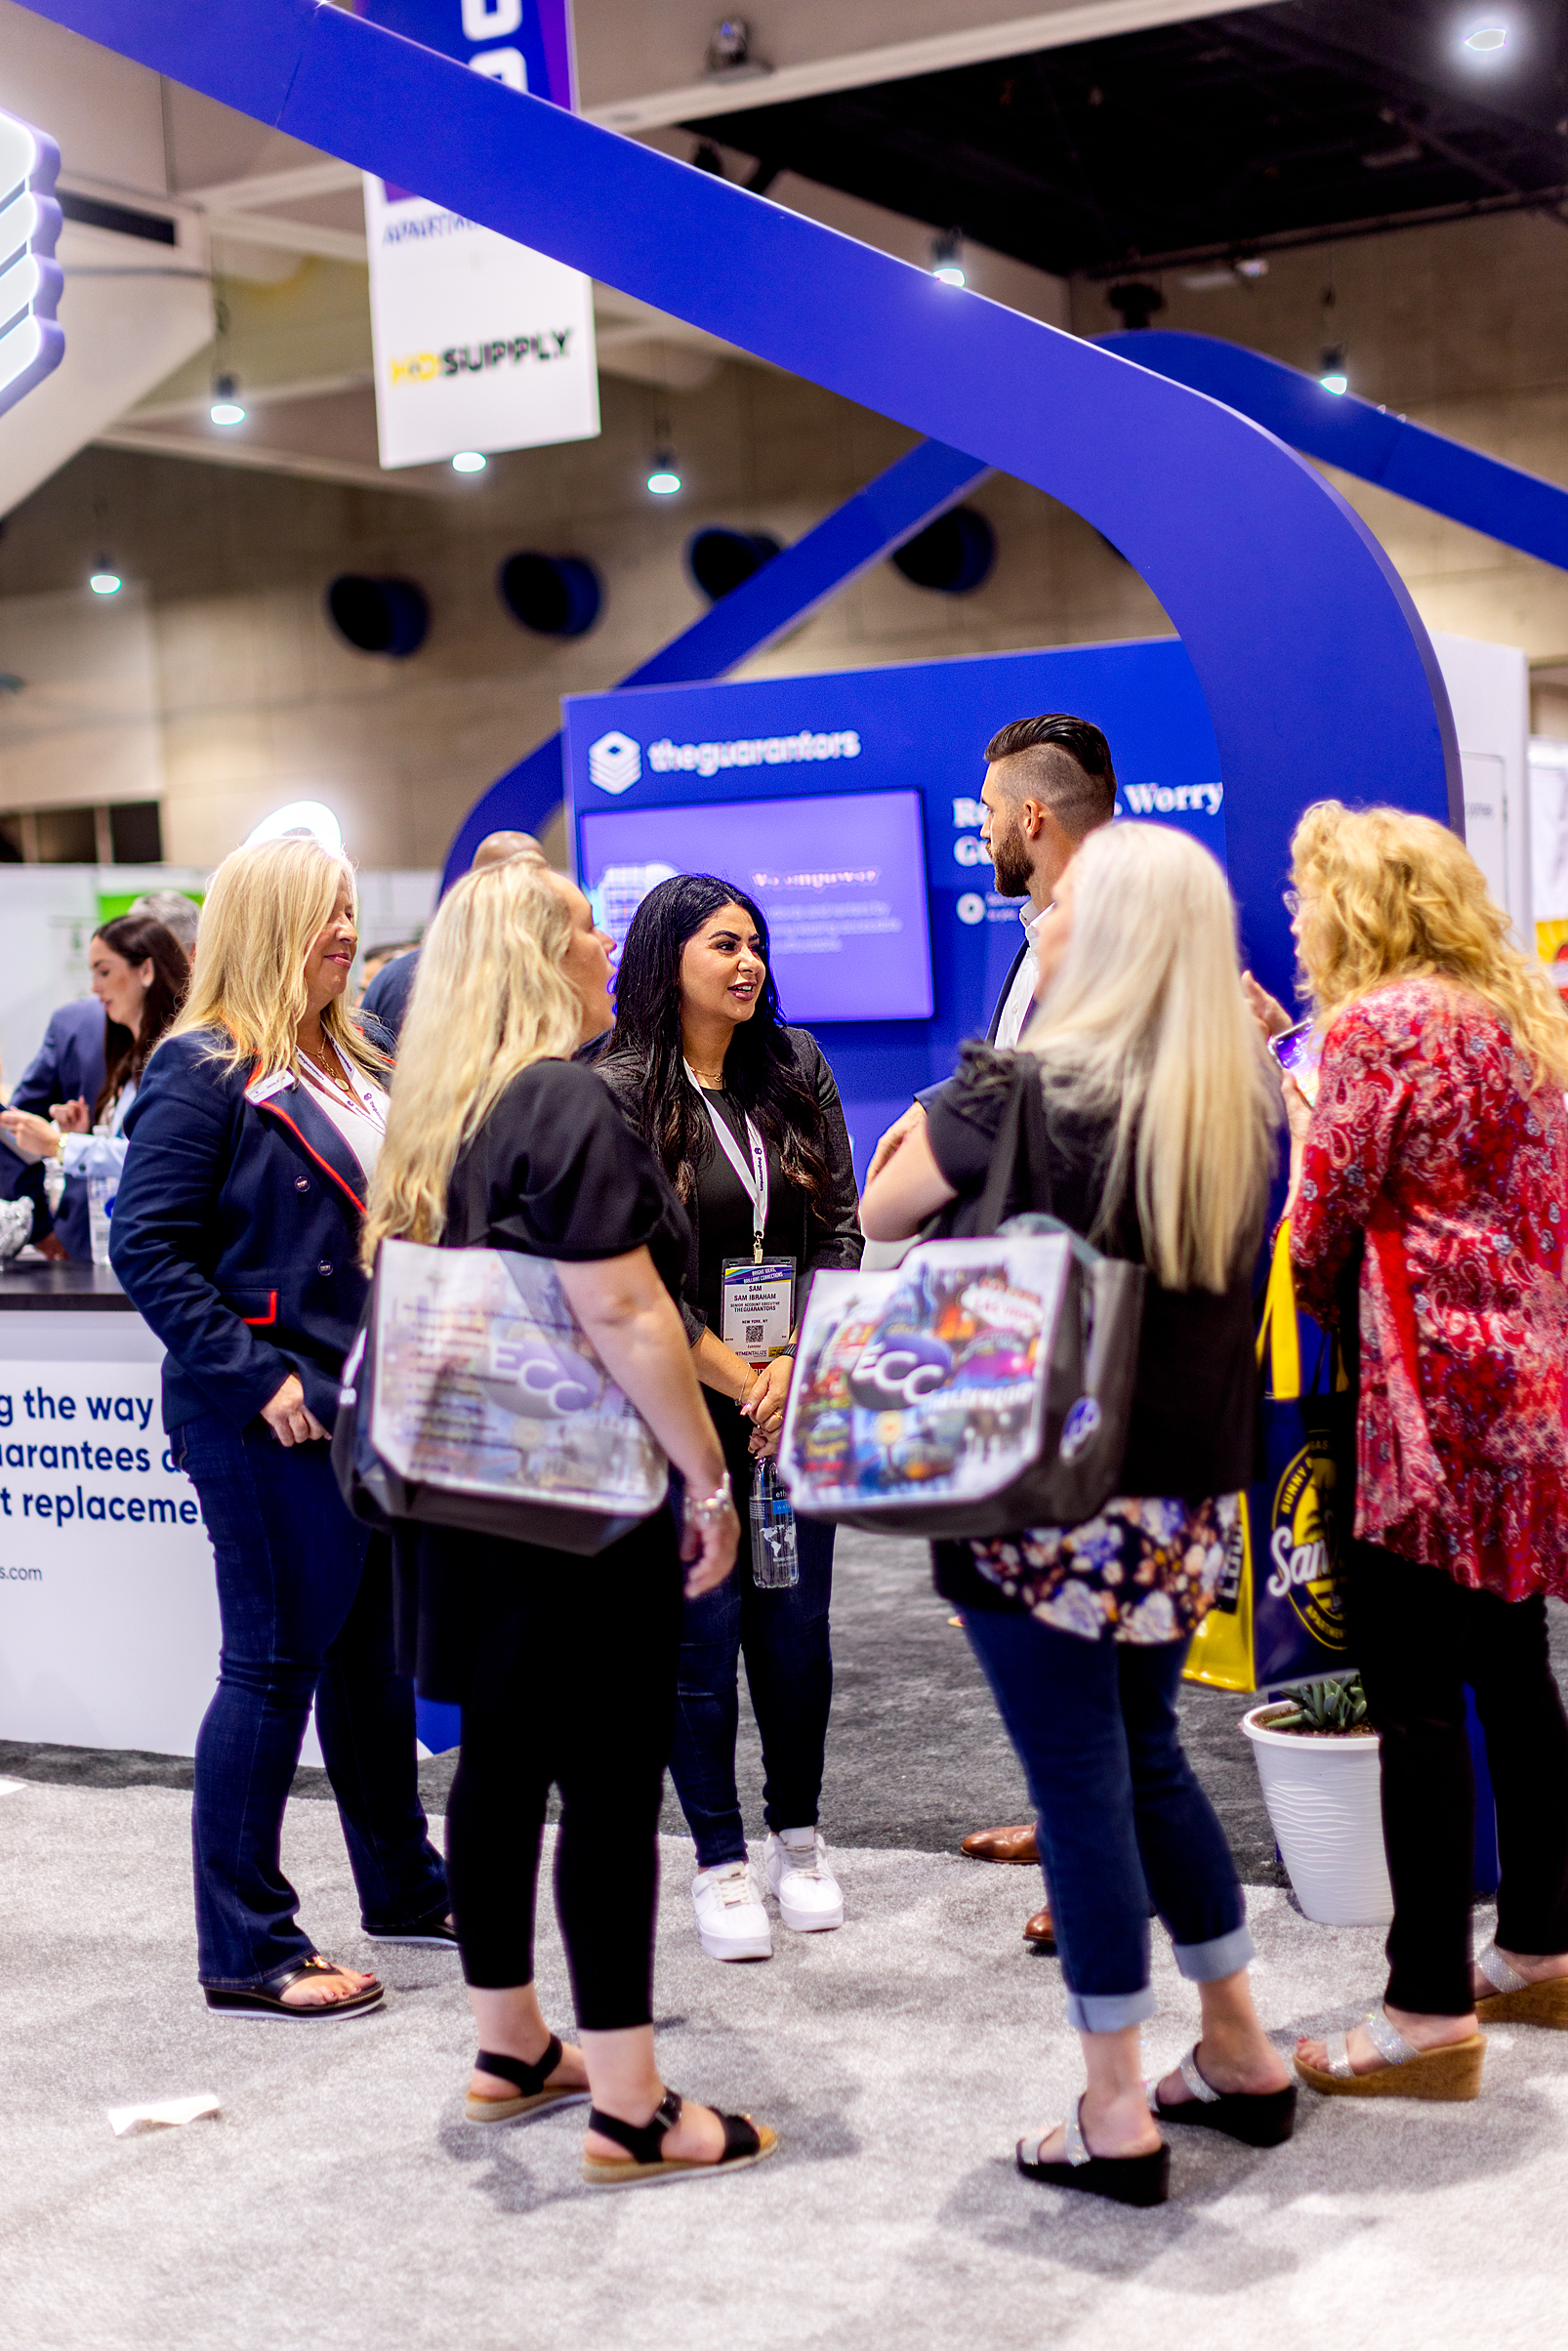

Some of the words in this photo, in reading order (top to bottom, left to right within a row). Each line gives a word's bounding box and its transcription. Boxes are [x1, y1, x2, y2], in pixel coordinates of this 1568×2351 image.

[647, 730, 861, 777] theguarantors
[1124, 781, 1224, 815] Worry
[851, 1341, 944, 1406] ECC
[22, 1386, 76, 1421] the
[86, 1396, 153, 1430] way
[0, 1440, 150, 1473] arantees
[22, 1485, 204, 1527] replaceme
